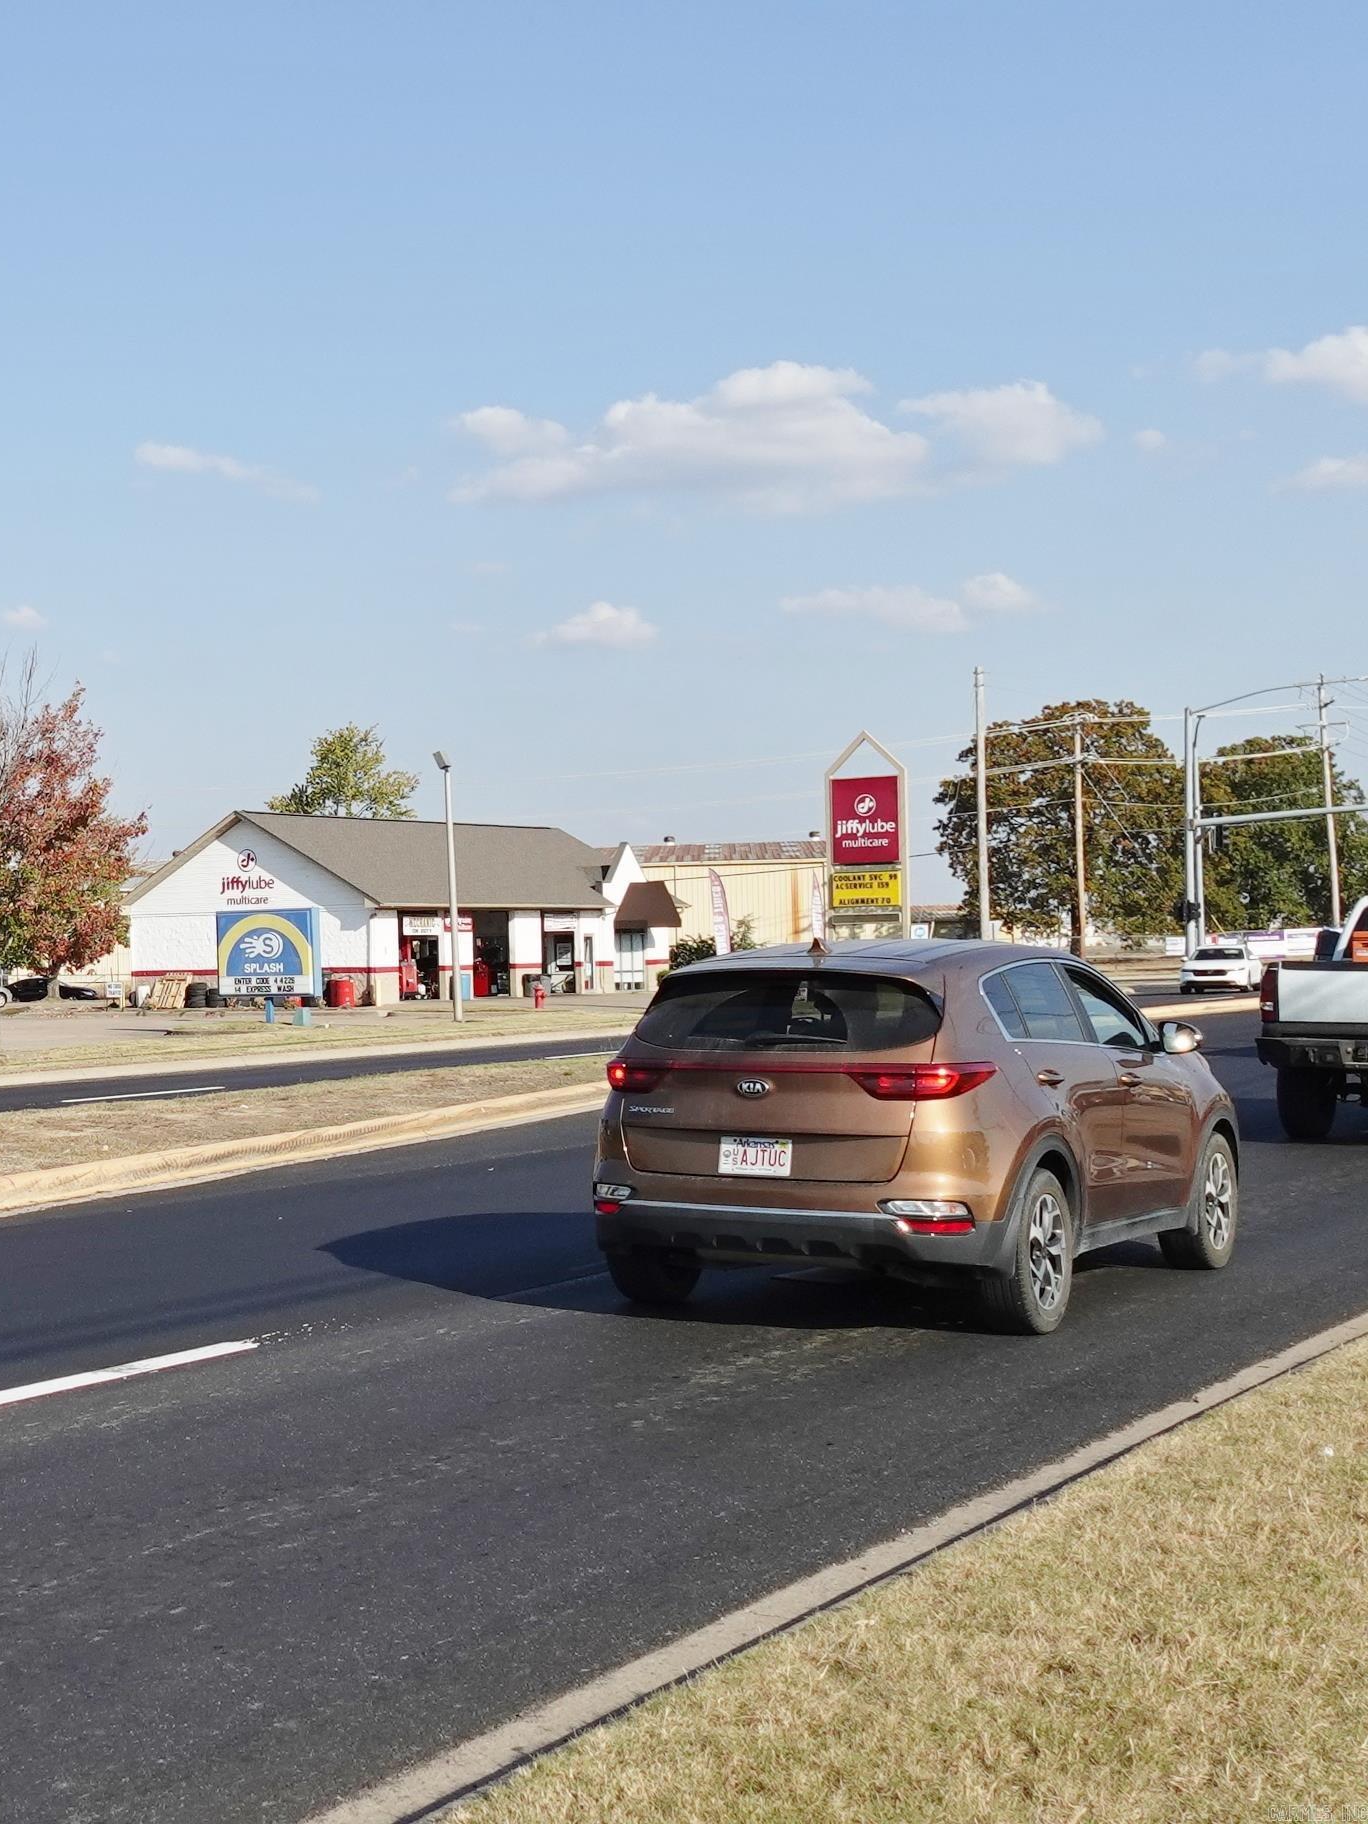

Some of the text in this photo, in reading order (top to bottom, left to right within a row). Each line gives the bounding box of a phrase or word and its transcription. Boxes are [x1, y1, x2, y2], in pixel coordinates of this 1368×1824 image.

[835, 818, 896, 837] jiffylube
[842, 837, 889, 848] multicare
[220, 875, 275, 894] jiffylube
[226, 895, 269, 905] multicare
[244, 963, 284, 973] SPLASH
[234, 977, 252, 985] ENTER
[256, 977, 270, 985] CODE
[246, 985, 271, 993] EXPRESS
[277, 985, 295, 993] WASH
[741, 1082, 763, 1093] KIA
[741, 1149, 786, 1167] AJTUC
